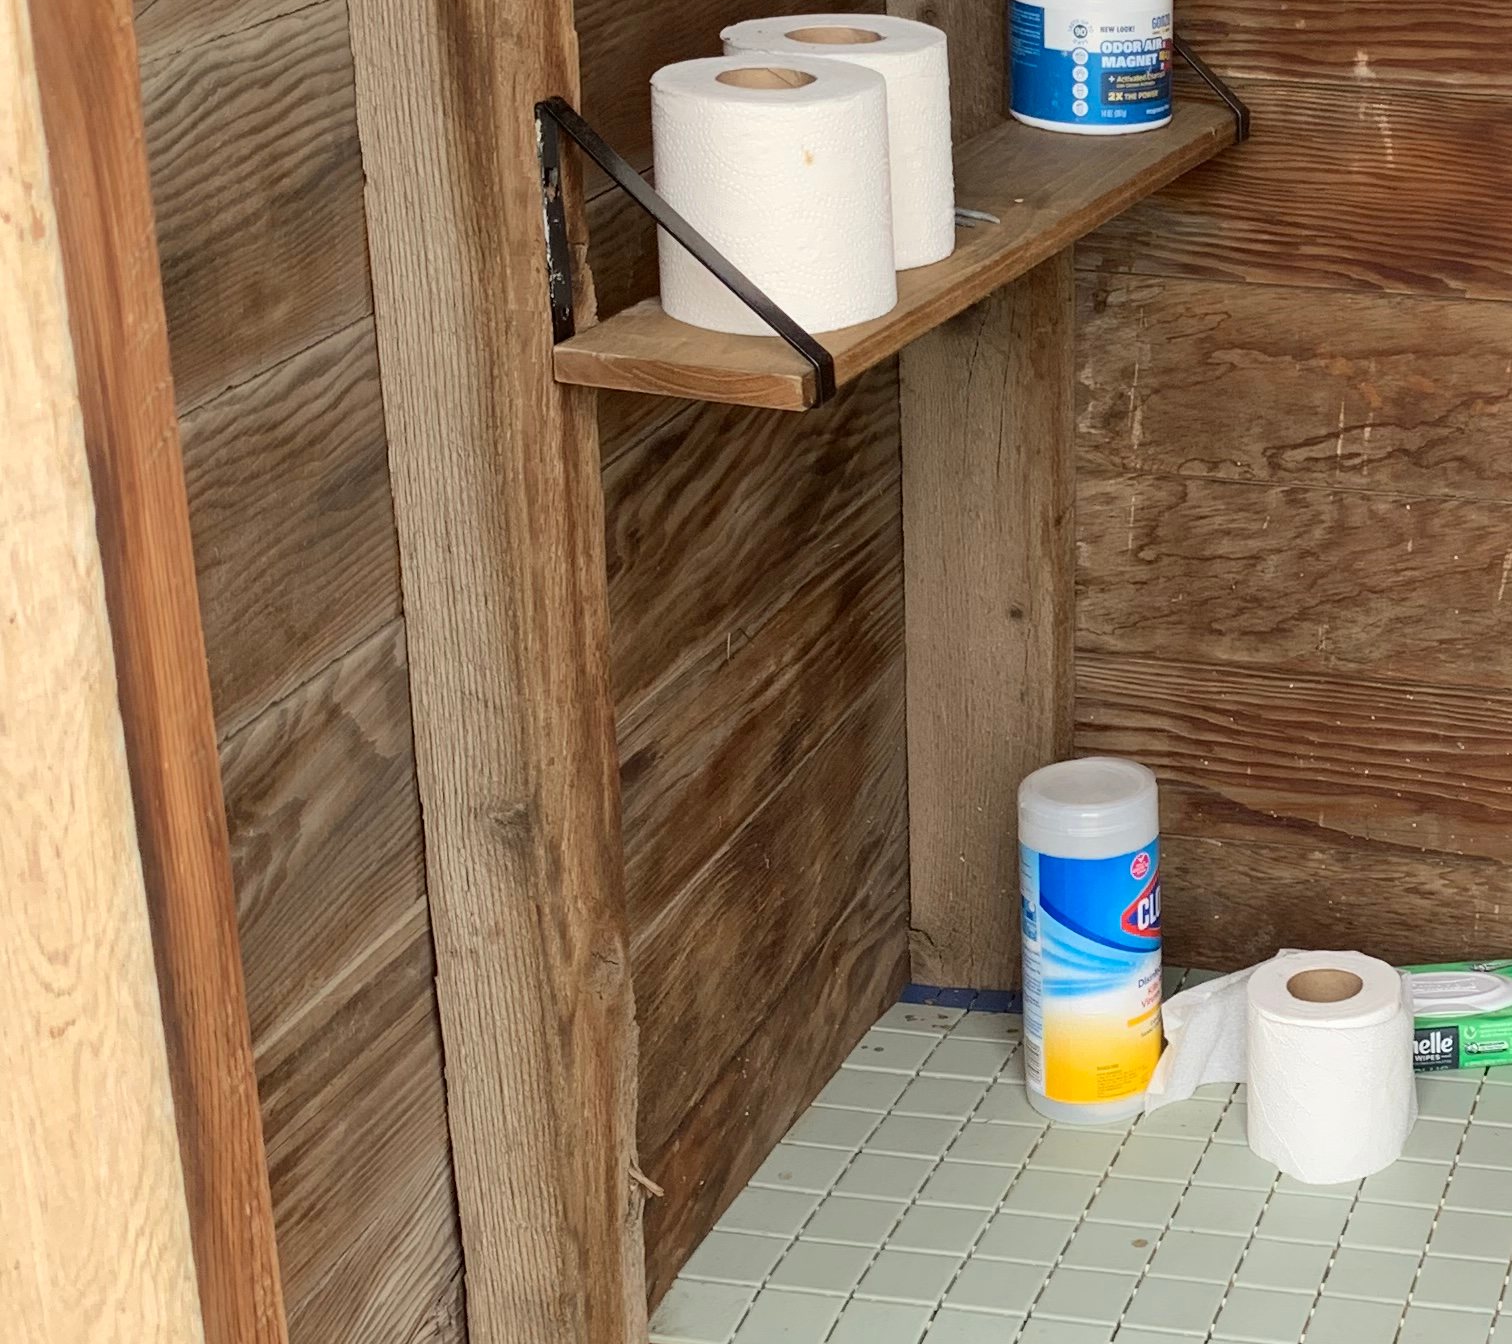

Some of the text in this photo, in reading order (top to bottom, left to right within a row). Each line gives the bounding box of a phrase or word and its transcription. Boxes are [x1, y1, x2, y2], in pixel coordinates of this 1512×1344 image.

[1117, 25, 1135, 33] LOOK!
[1101, 41, 1142, 54] ODOR
[1144, 38, 1162, 52] AIR
[1101, 53, 1158, 68] MAGNET
[1109, 92, 1123, 102] 2X
